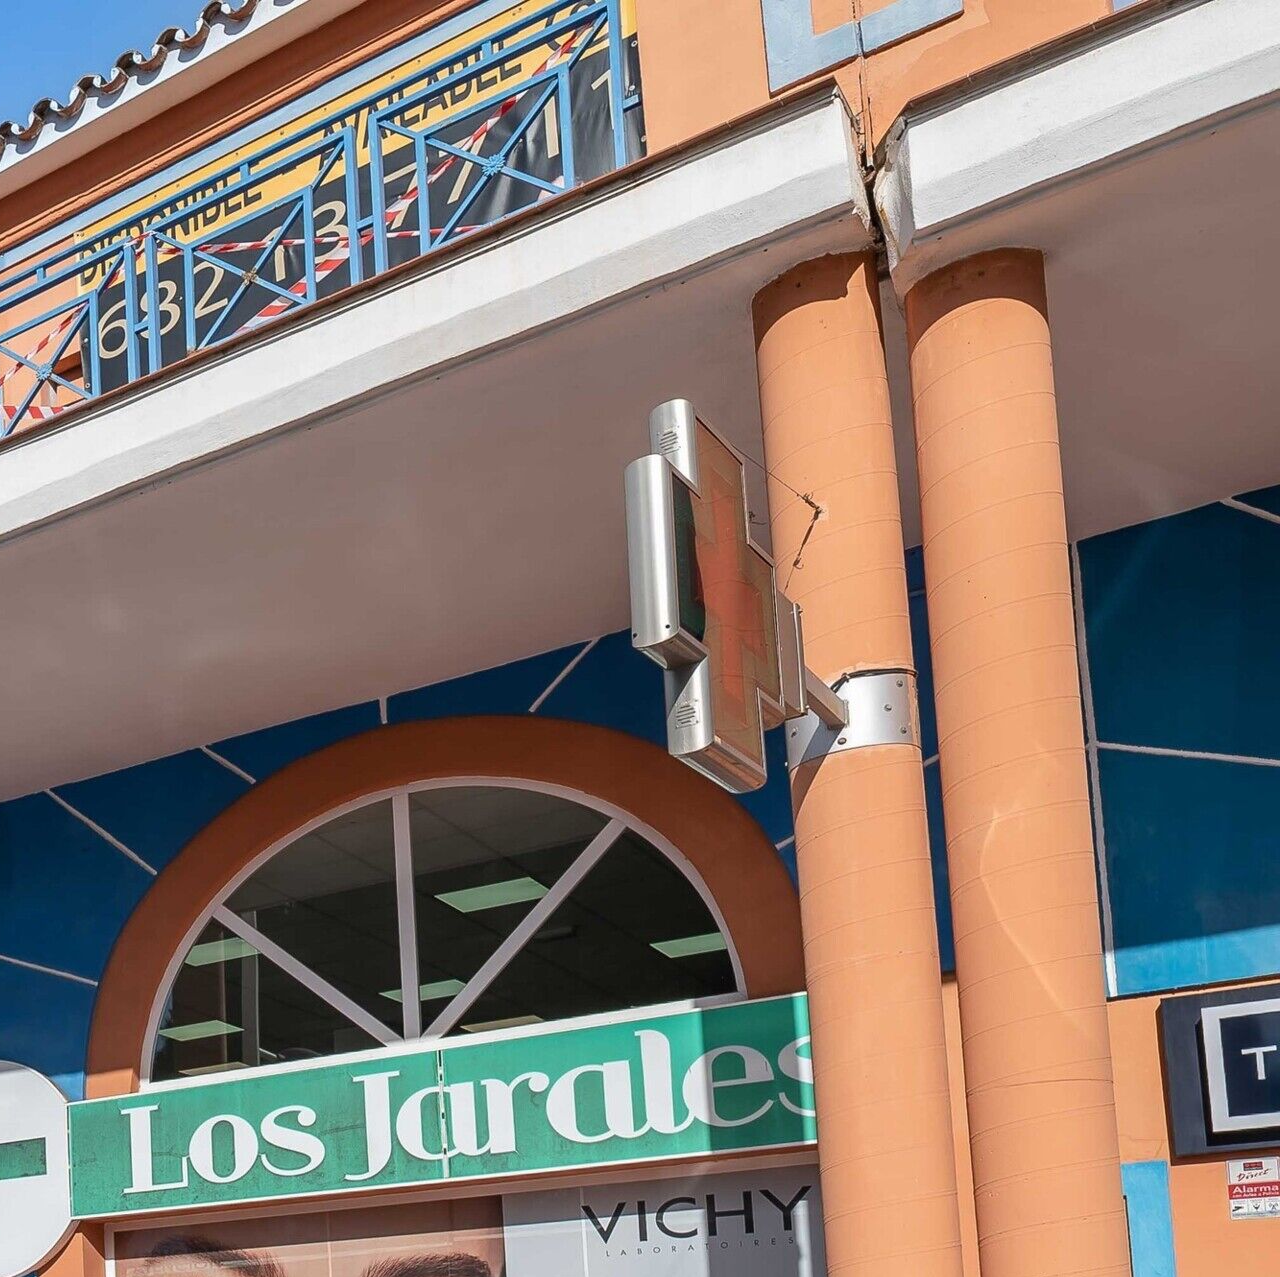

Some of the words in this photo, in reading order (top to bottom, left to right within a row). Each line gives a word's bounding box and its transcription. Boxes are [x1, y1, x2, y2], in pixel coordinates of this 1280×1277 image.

[120, 1103, 326, 1195] Los
[345, 1029, 817, 1181] Jarales
[1233, 1185, 1279, 1194] Alarma
[581, 1185, 812, 1244] VICHY
[606, 1237, 794, 1257] LABORATOIRES
